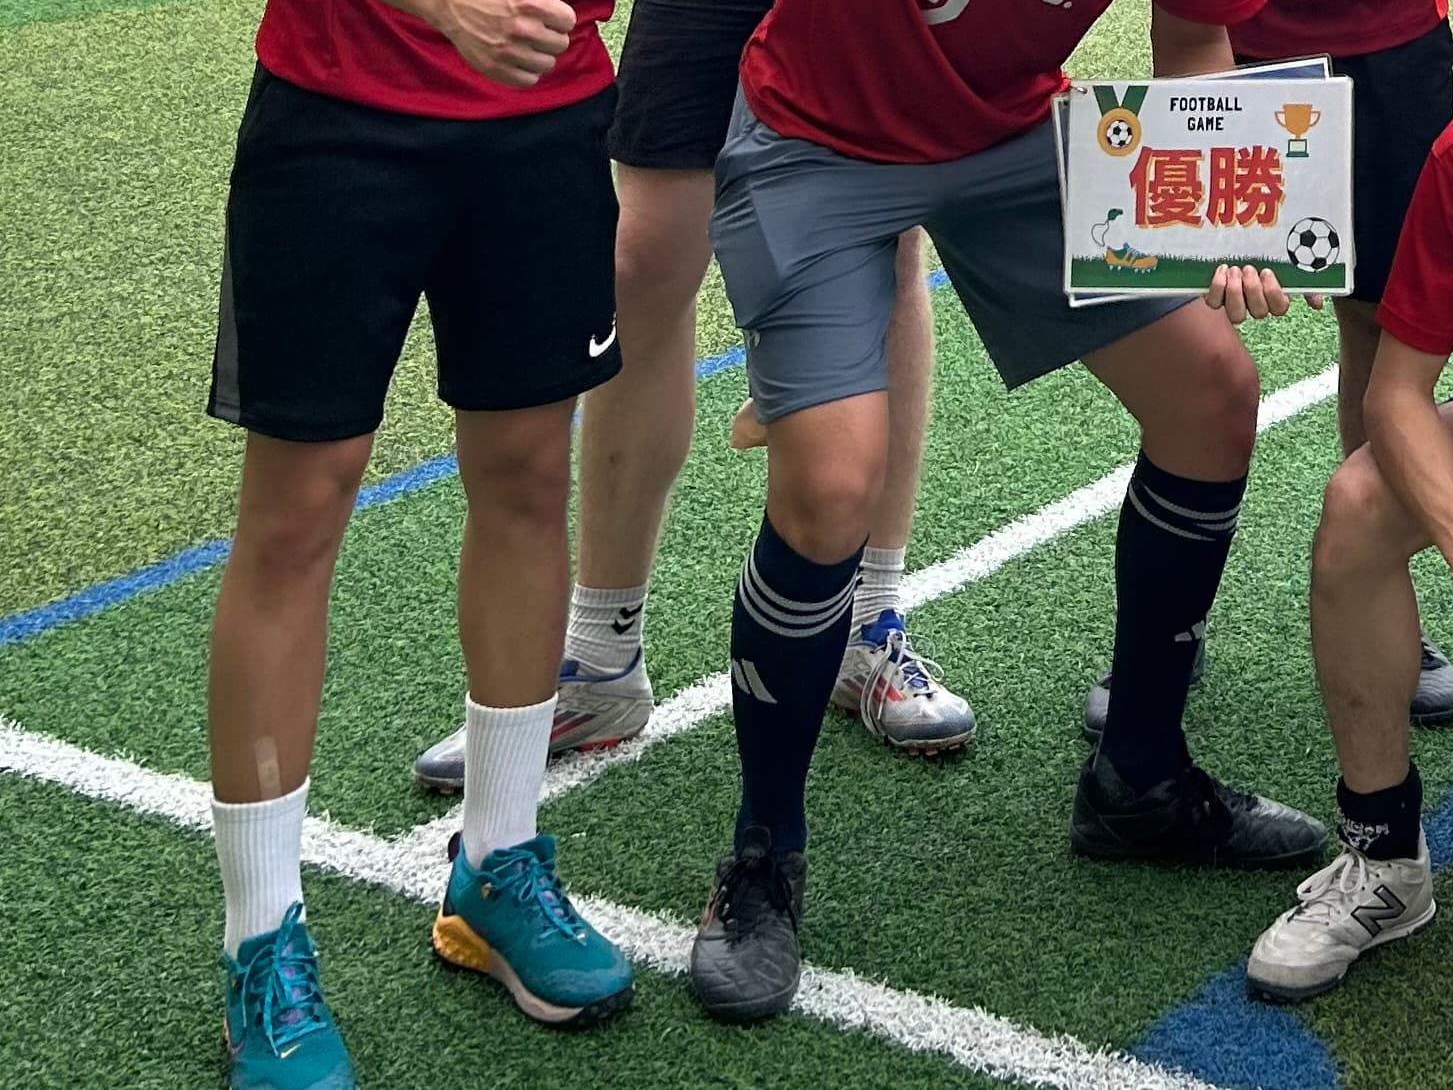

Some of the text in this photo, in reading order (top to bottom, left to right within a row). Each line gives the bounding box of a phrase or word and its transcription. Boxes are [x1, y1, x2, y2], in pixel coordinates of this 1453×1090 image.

[1169, 97, 1242, 112] FOOTBALL
[1187, 117, 1224, 131] GAME
[1129, 145, 1286, 228] 優勝
